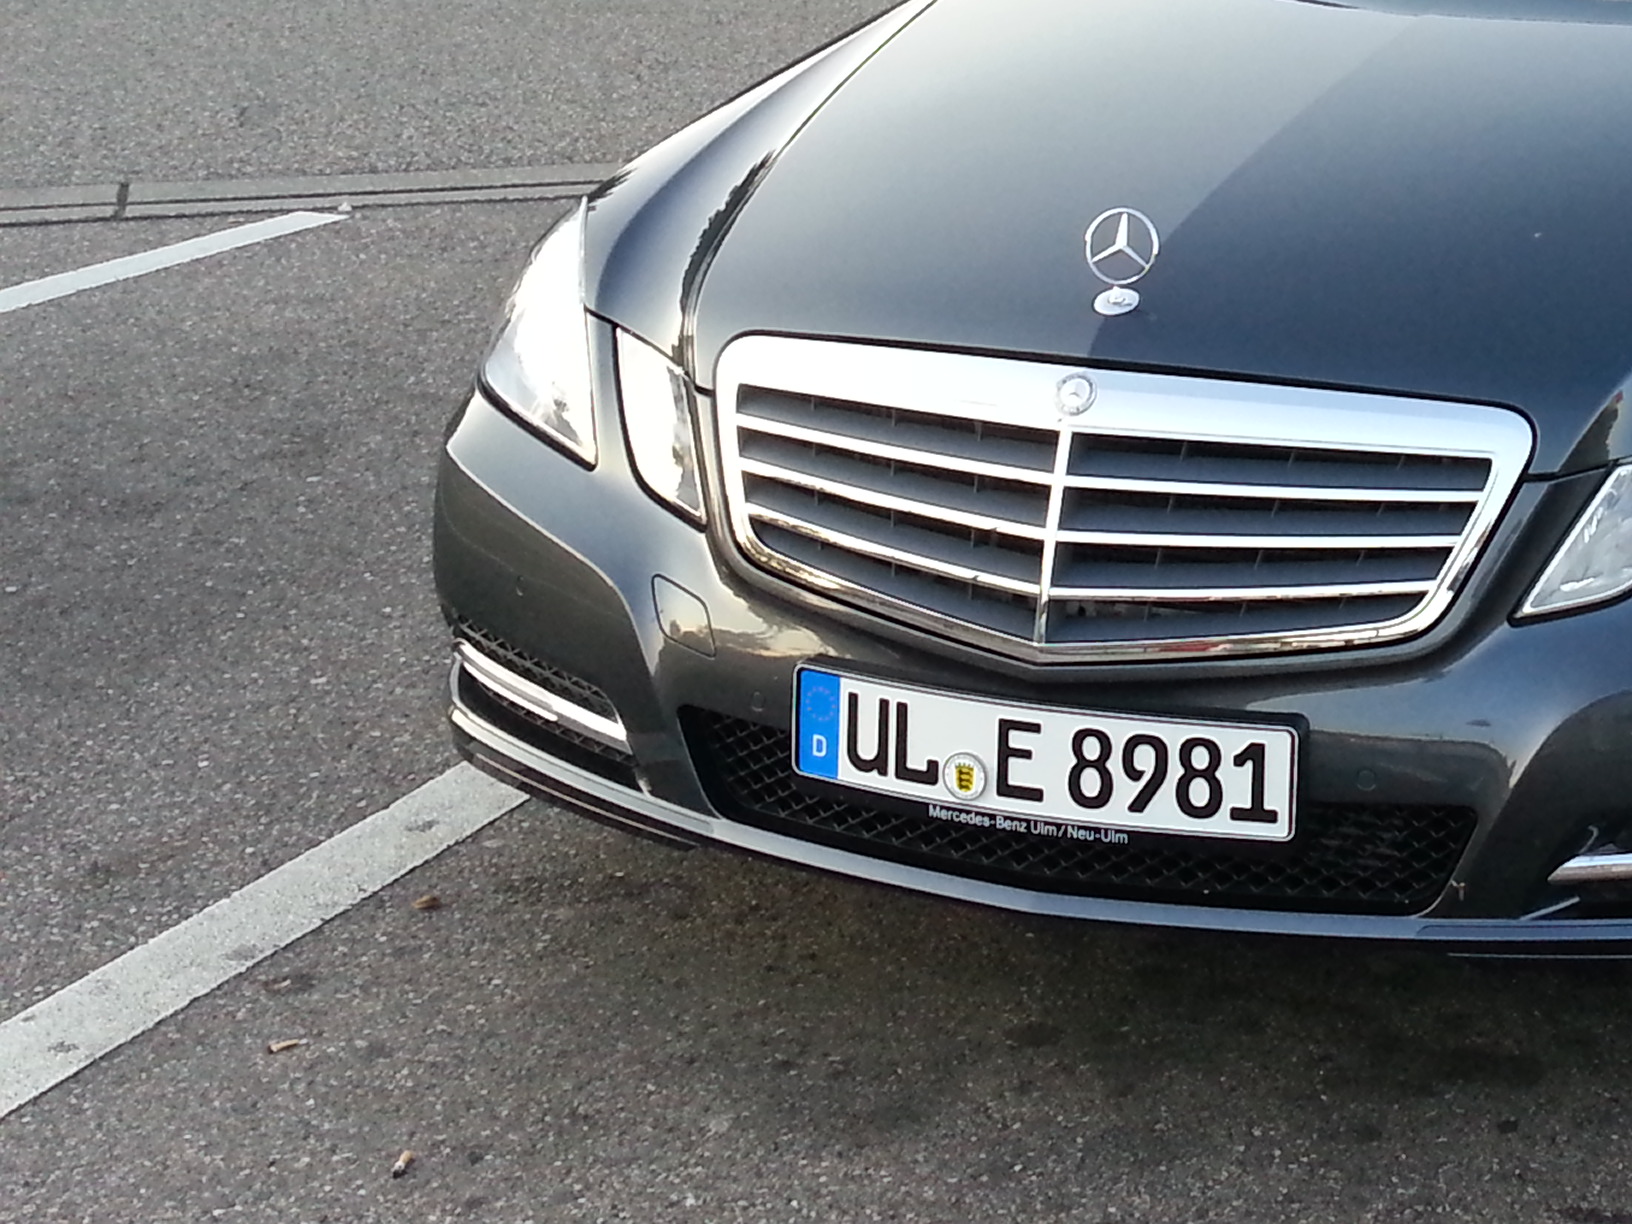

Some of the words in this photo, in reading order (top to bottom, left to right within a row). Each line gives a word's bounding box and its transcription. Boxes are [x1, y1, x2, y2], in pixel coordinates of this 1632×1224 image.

[813, 734, 827, 757] D
[847, 691, 939, 786] UL
[996, 717, 1044, 803] E
[1067, 727, 1279, 825] 8981
[928, 804, 1027, 833] Mercedes-Benz
